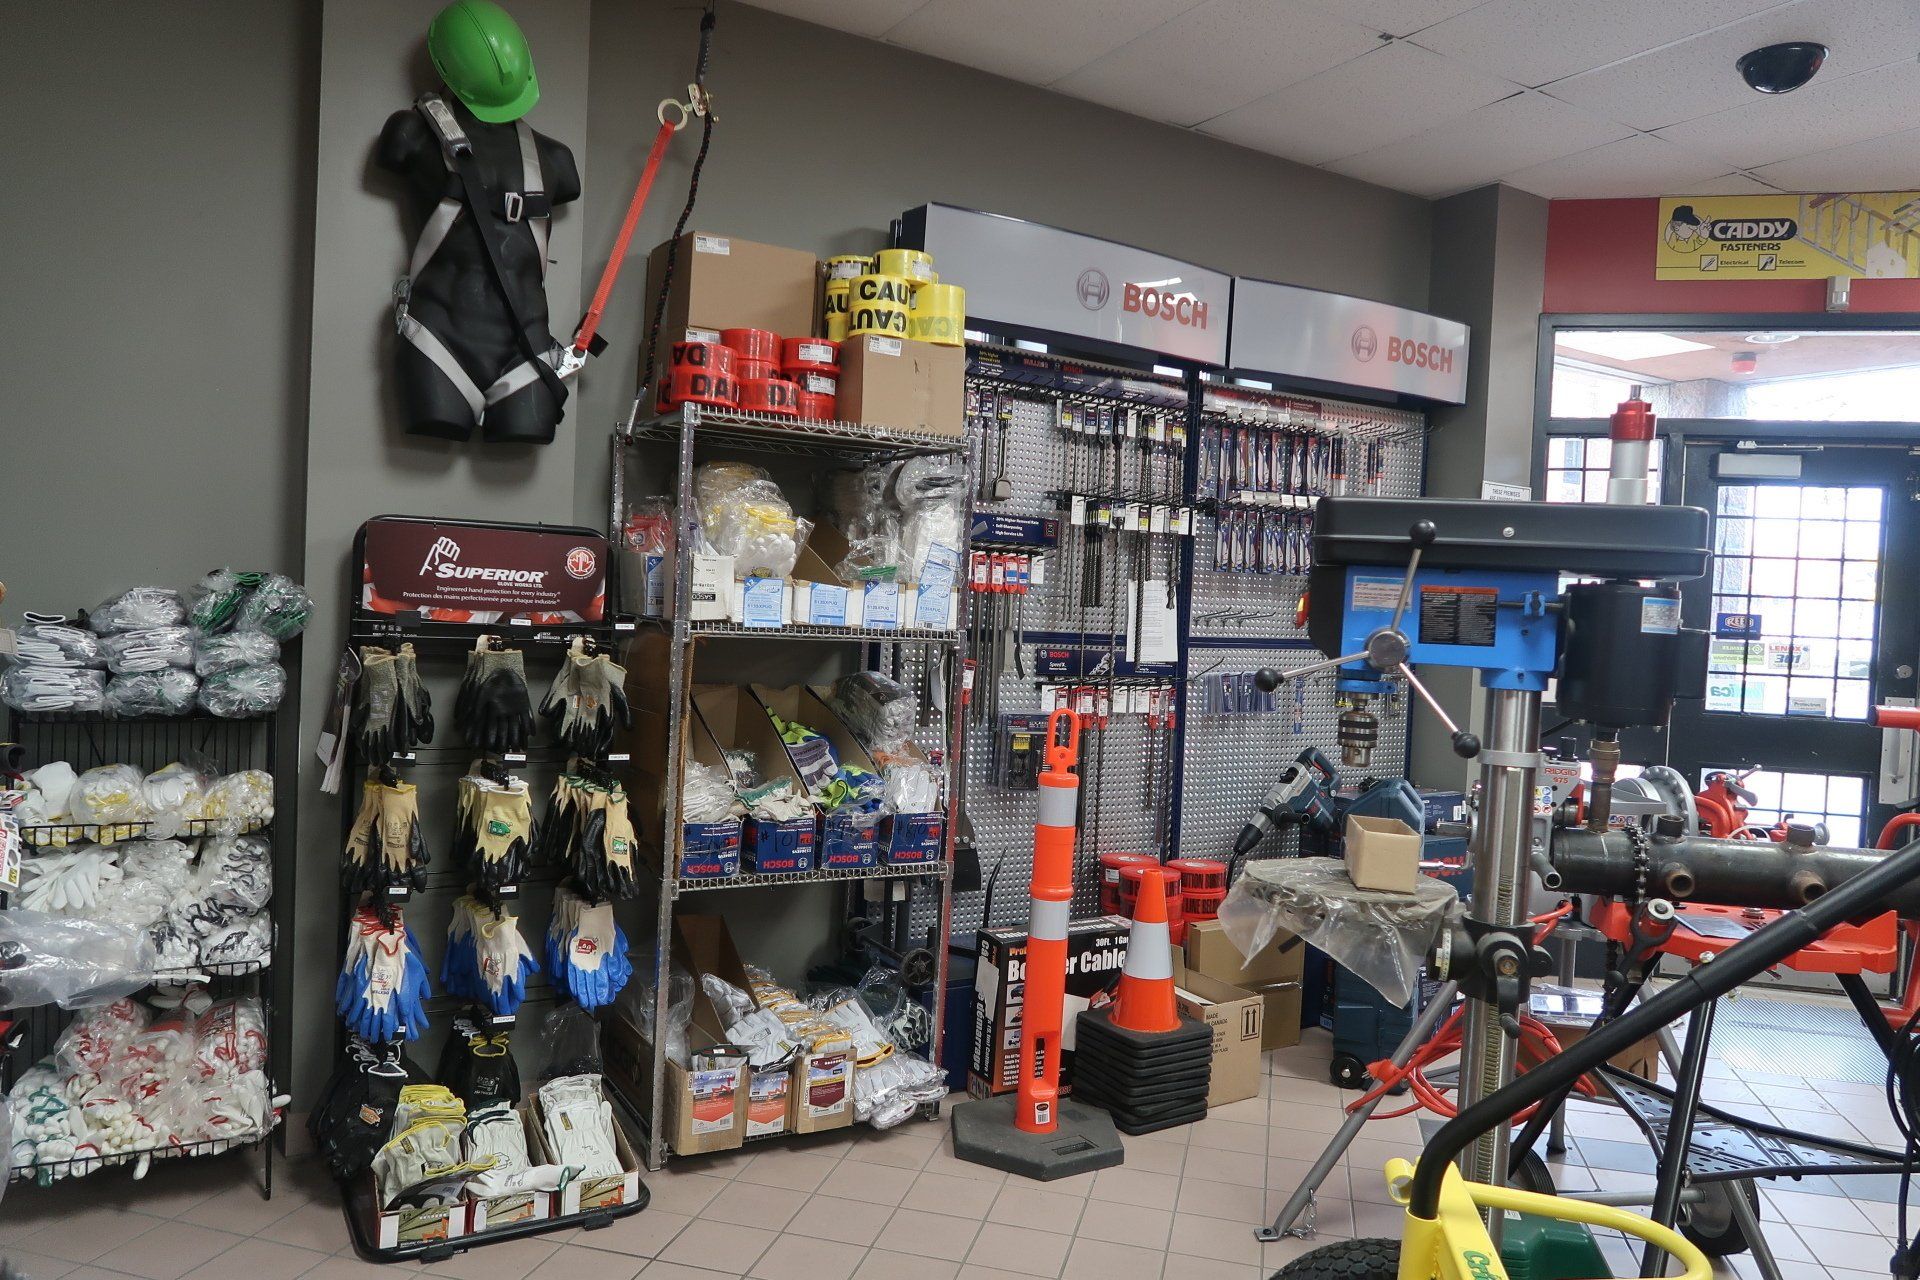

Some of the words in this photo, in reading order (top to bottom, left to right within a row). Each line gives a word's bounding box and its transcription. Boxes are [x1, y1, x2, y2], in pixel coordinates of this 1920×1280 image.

[1713, 221, 1791, 239] CADDY
[1721, 242, 1781, 251] FASTENERS
[1123, 282, 1208, 330] BOSCH
[1387, 342, 1453, 373] BOSCH
[435, 562, 545, 583] SUPERIOR
[437, 585, 467, 593] Engineered
[468, 586, 483, 594] hand
[484, 588, 512, 596] protection
[403, 591, 431, 599] Protection
[461, 594, 499, 602] perfectionnée
[514, 597, 533, 605] chaque
[1545, 768, 1577, 776] RIDGID
[829, 854, 859, 863] BOSCH
[894, 851, 923, 859] BOSCH
[687, 864, 720, 874] BOSCH
[763, 860, 795, 869] BOSCH
[402, 1212, 412, 1220] 12
